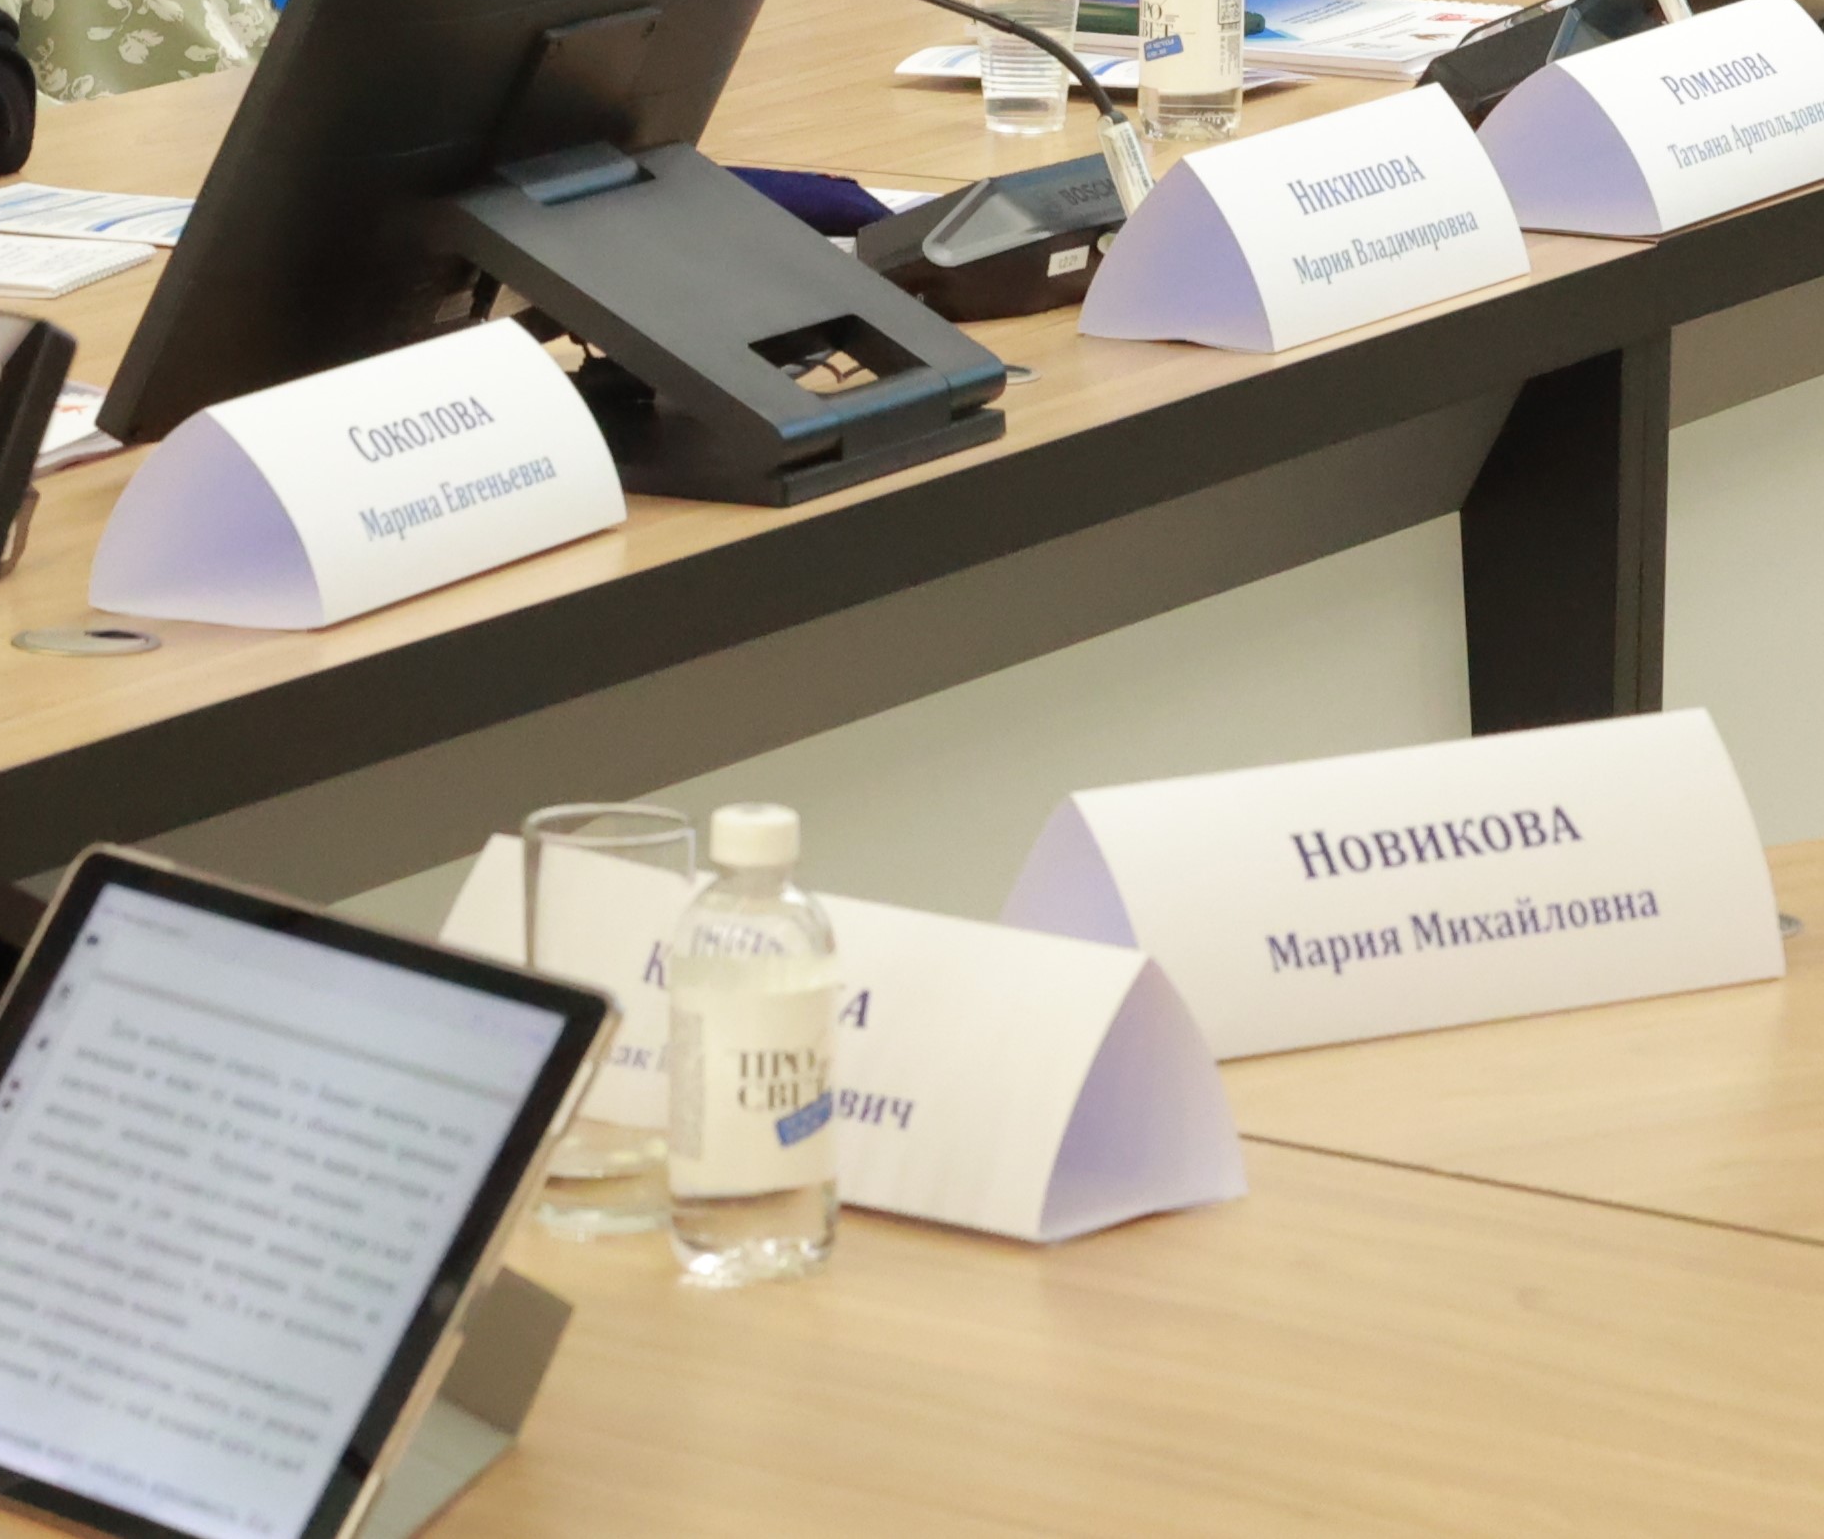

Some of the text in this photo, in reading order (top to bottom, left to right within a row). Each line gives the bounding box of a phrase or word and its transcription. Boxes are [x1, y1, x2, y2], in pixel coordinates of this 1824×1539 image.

[1660, 52, 1778, 105] РОМАНОВА
[1286, 155, 1426, 215] НИКИШОВА
[1667, 133, 1733, 169] Татьяна
[1292, 211, 1480, 285] Мария Владимировна
[348, 396, 495, 463] СОКОЛОВА
[359, 456, 557, 541] Марина Евгеньевна
[1290, 804, 1584, 880] НОВИКОВА
[1265, 888, 1660, 975] Мария Михайловна
